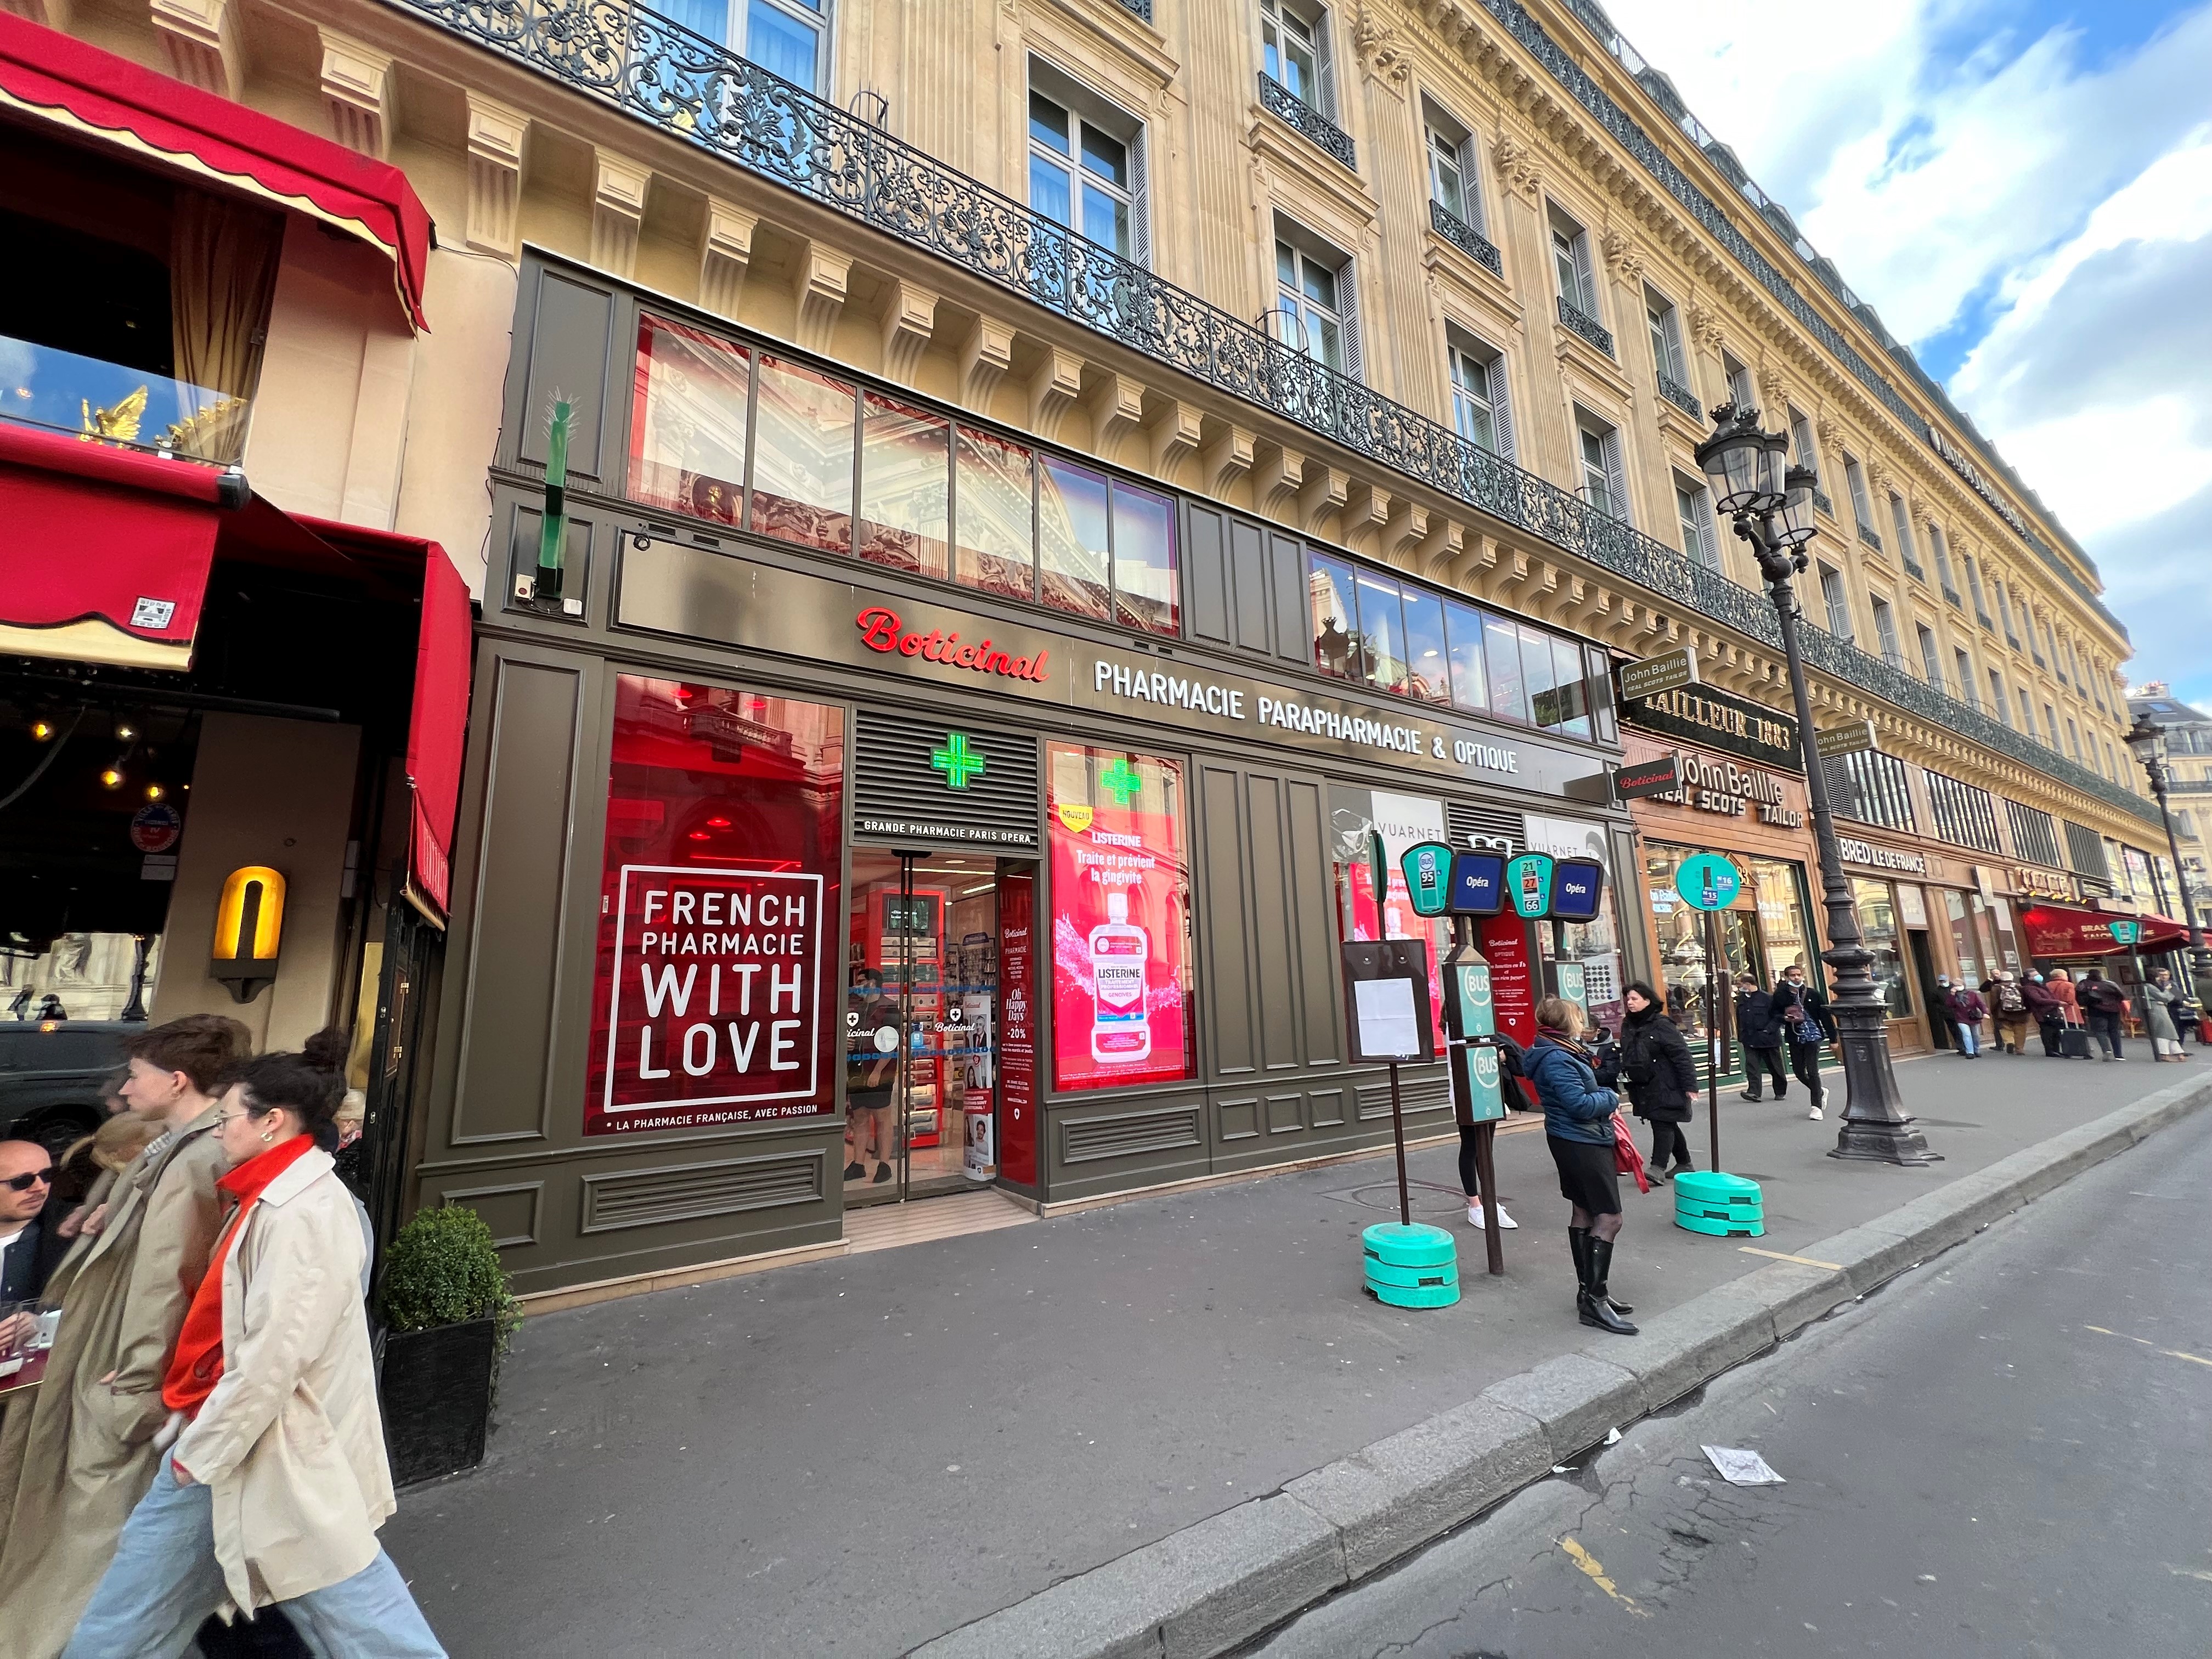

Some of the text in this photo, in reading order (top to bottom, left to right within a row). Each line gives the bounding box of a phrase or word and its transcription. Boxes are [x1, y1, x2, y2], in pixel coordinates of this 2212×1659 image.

[857, 607, 1049, 684] Boticinal
[1625, 658, 1687, 683] John Baillie
[1644, 678, 1663, 687] SCOTS
[1666, 670, 1688, 681] TAILOR
[1094, 661, 1518, 774] PHARMACIE PARAPHARMACIE & OPTIQUE
[1756, 718, 1791, 751] 1883
[1818, 729, 1867, 745] ohn Baillie
[1620, 770, 1674, 788] Boticinal
[1726, 762, 1784, 805] Baillie
[1063, 810, 1090, 820] NOUVEAU
[1701, 790, 1746, 816] SCOTS
[1762, 804, 1803, 828] TAILOR
[864, 820, 1031, 844] GRANDE PHARMACIE PARIS OPERA
[1092, 832, 1141, 847] LISTERINE
[1378, 822, 1441, 840] VUARNET
[1076, 850, 1155, 868] Traite et prévient
[1839, 838, 1925, 873] BRED ILE DE FRANCE
[1523, 862, 1533, 871] 21
[1091, 868, 1142, 885] la gingivite
[1421, 872, 1434, 882] 95
[1466, 876, 1489, 889] Opéra
[1525, 879, 1535, 888] 27
[1566, 883, 1586, 895] Opéra
[644, 890, 805, 927] FRENCH
[1526, 900, 1538, 910] 66
[642, 932, 804, 956] PHARMACIE
[1098, 968, 1140, 978] LISTERINE
[1566, 972, 1584, 988] BUS
[641, 963, 802, 1017] WITH
[1468, 975, 1489, 991] BUS
[1012, 988, 1022, 1000] Oh
[1006, 998, 1027, 1012] Happy
[1008, 1010, 1024, 1023] Days
[934, 1022, 975, 1032] Boticinal
[1007, 1028, 1026, 1039] -20%
[640, 1020, 802, 1079] LOVE
[1477, 1056, 1498, 1074] BUS
[616, 1104, 817, 1130] LA PHARMACIE FRANÇAISE, AVEC PASSION
